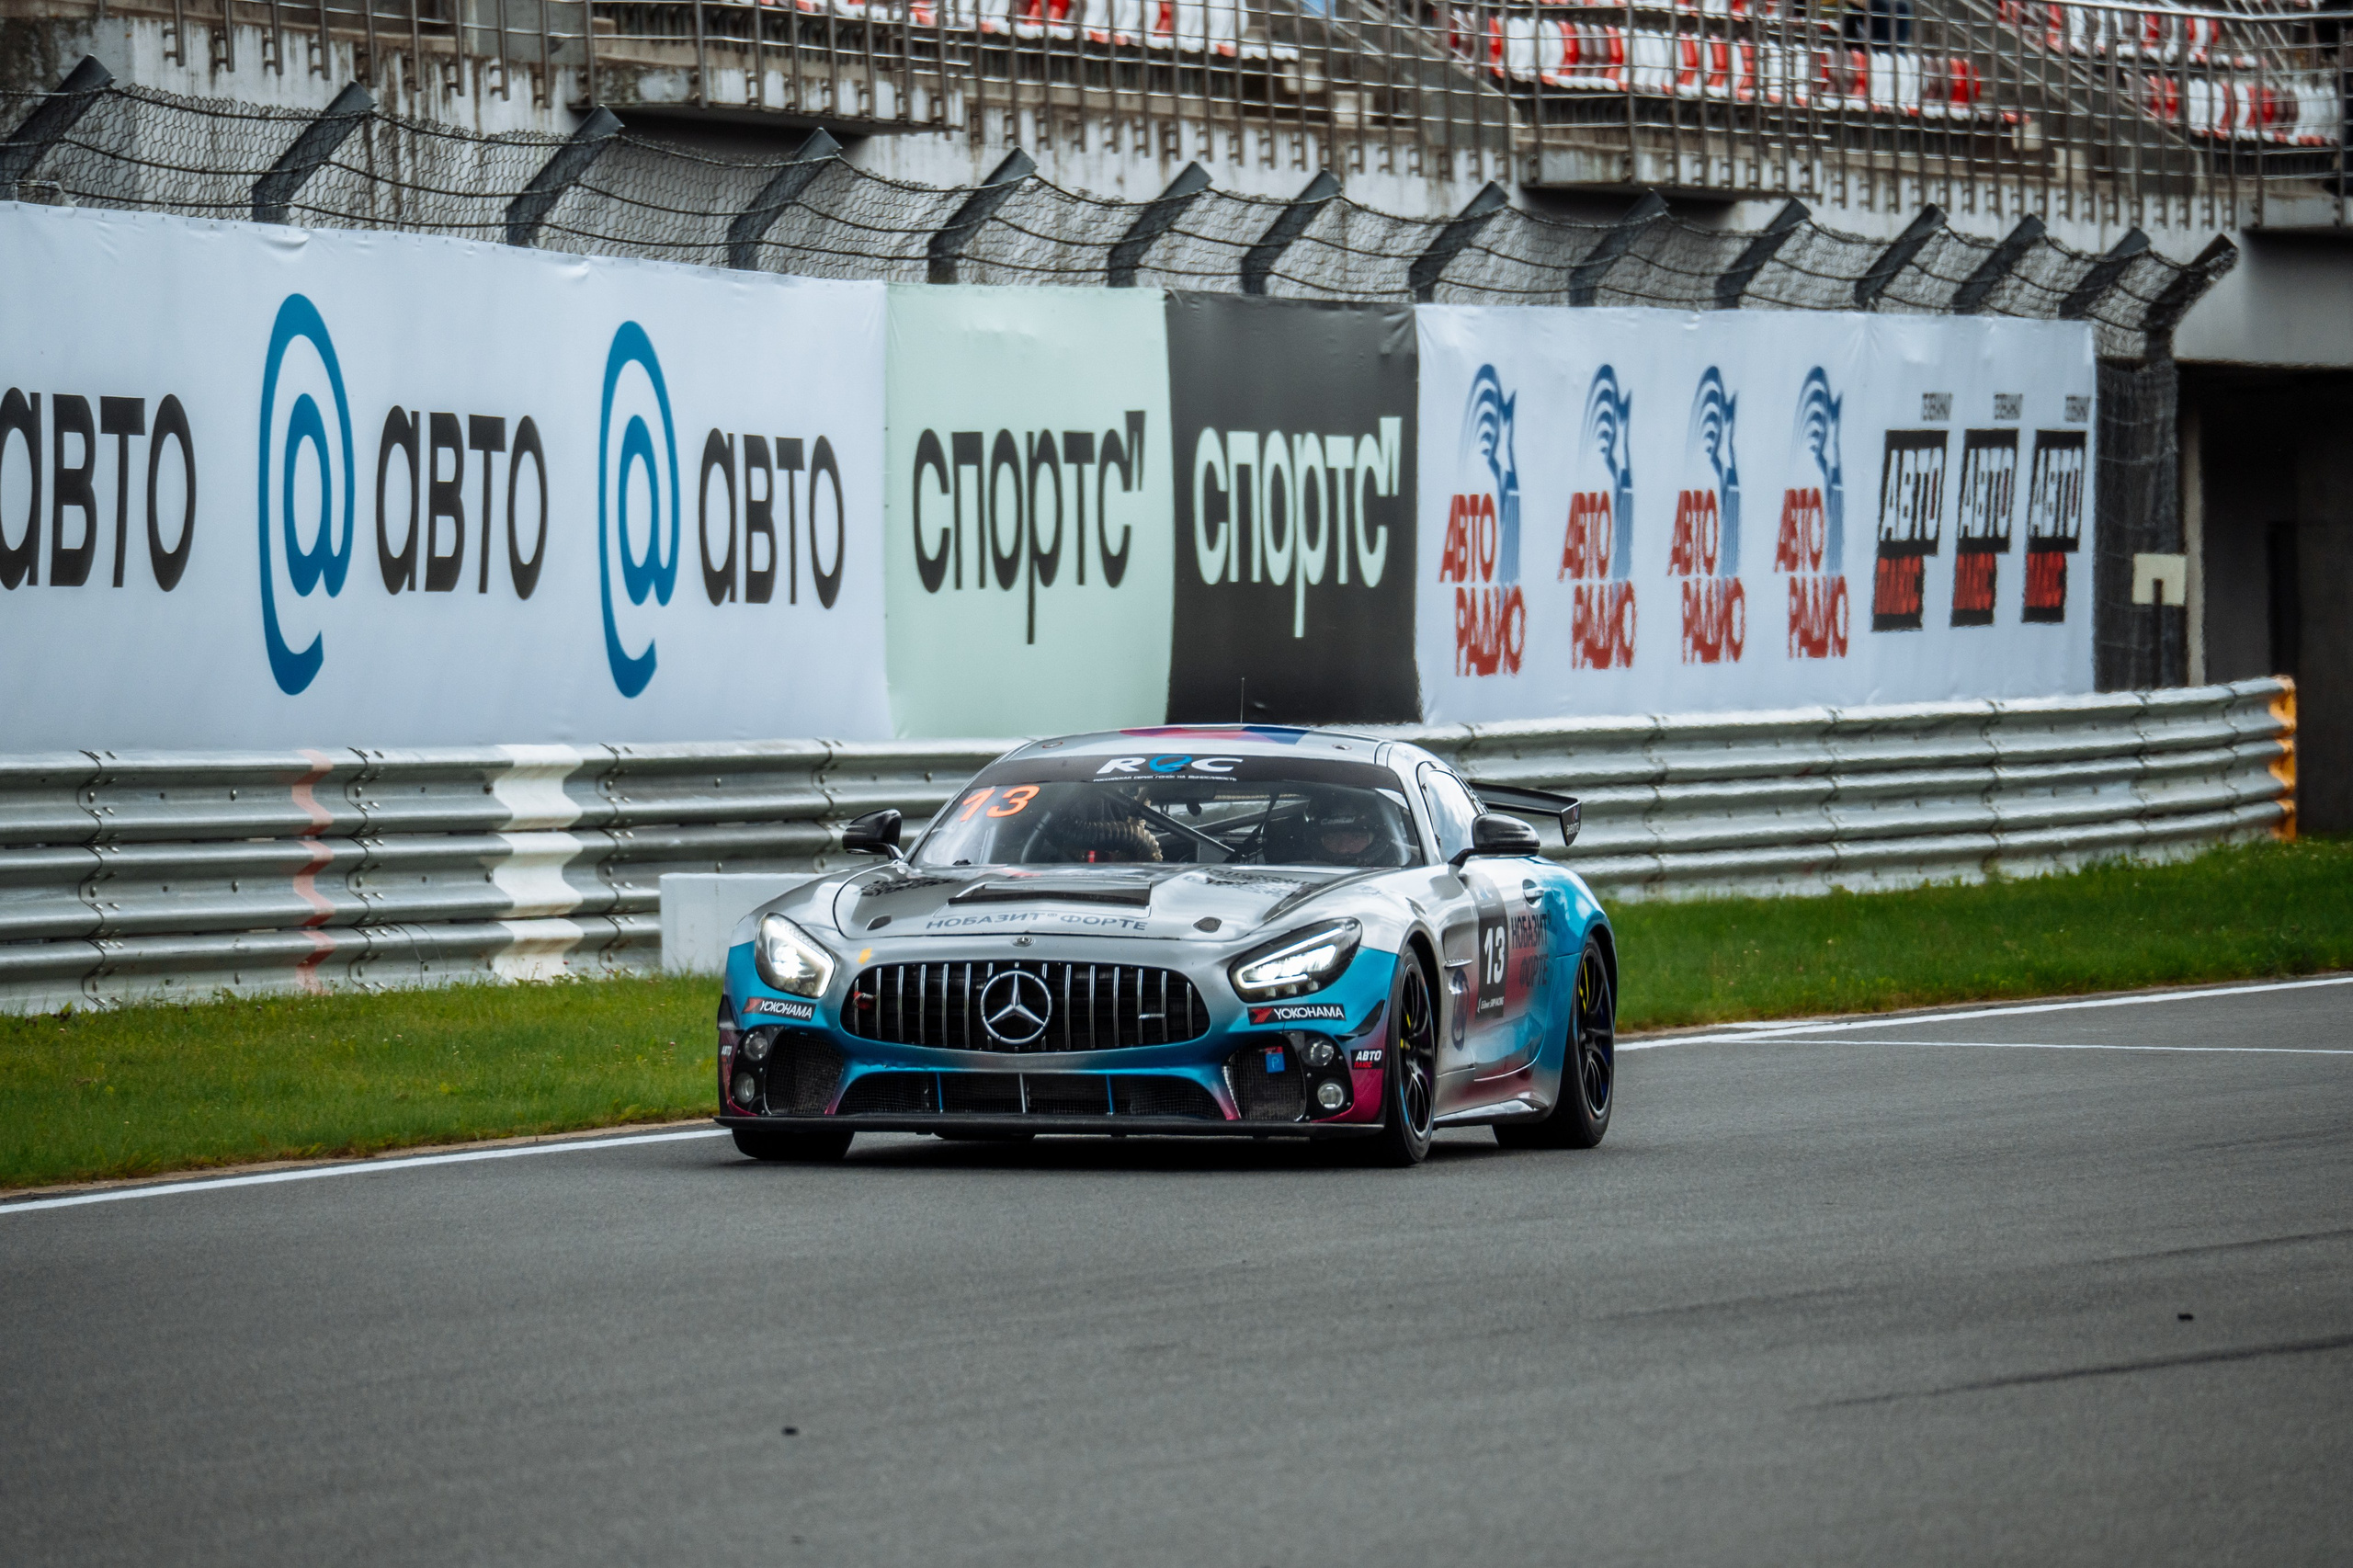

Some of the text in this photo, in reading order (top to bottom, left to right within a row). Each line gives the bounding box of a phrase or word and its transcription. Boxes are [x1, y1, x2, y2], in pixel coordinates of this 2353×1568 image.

[376, 404, 548, 601] авто
[699, 427, 845, 609] авто
[1556, 490, 1613, 580] АВТО
[1665, 488, 1720, 577] АВТО
[1772, 486, 1825, 573] АВТО
[1879, 447, 1944, 542] АВТО
[1958, 447, 2016, 540] АВТО
[2028, 447, 2085, 539] АВТО
[1438, 492, 1498, 584] АВТО
[960, 785, 1040, 823] 13
[1060, 914, 1150, 931] ФОРТЕ
[1483, 925, 1506, 985] 13
[759, 1000, 813, 1019] YOKOHAMA
[1273, 1006, 1345, 1020] YOKOHAMA
[1356, 1050, 1382, 1062] АВТО
